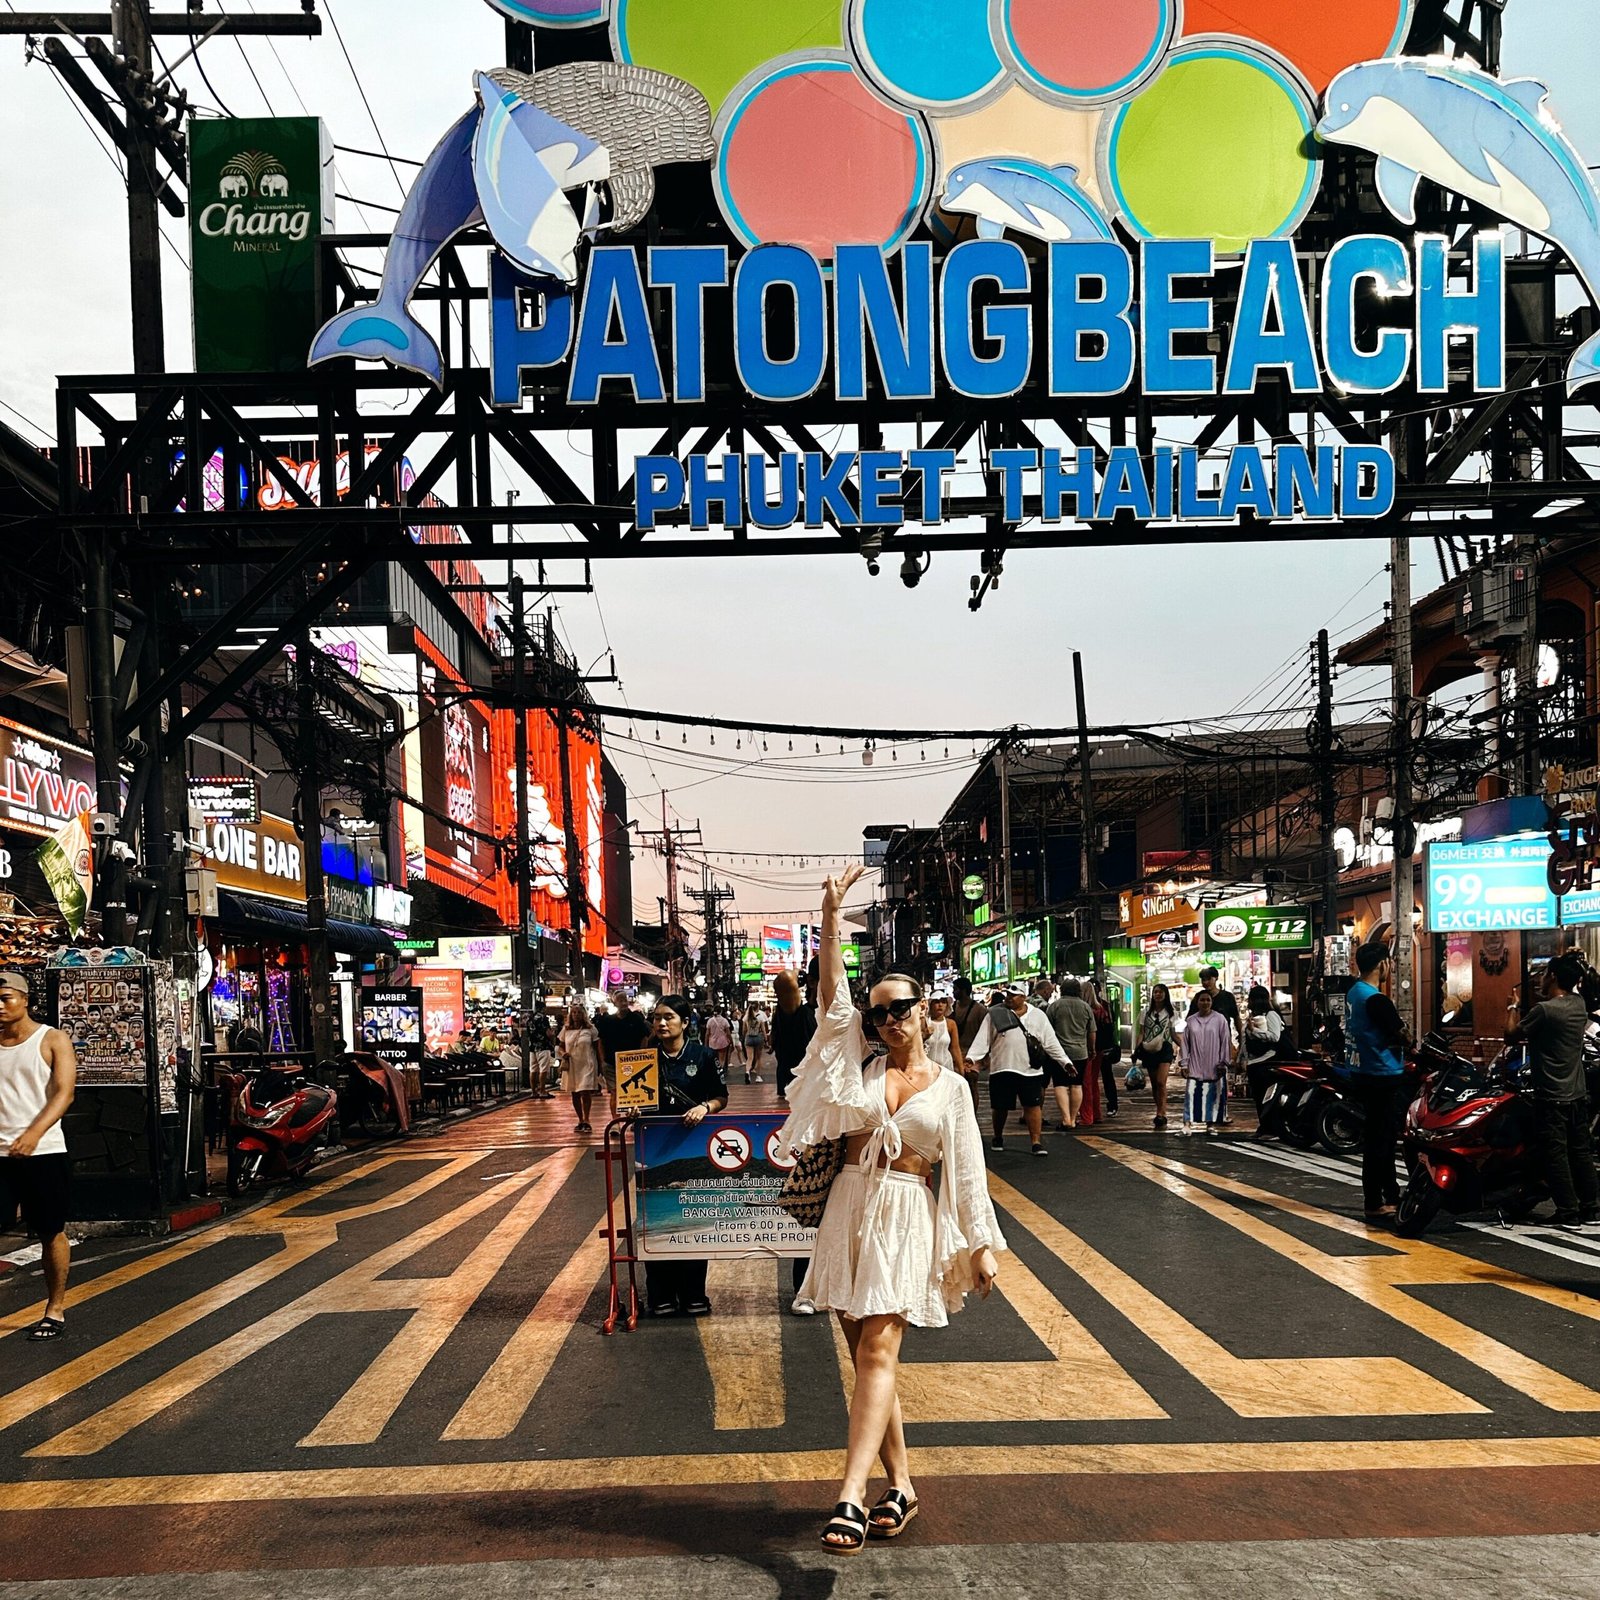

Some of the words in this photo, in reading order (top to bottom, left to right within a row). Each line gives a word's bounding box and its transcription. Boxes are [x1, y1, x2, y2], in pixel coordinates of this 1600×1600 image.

[199, 203, 312, 241] Chang
[634, 449, 957, 531] PHUKET
[988, 442, 1396, 525] THAILAND
[263, 836, 301, 881] BAR
[1434, 874, 1483, 905] 99
[1142, 896, 1175, 918] SINGHA
[1437, 908, 1549, 929] EXCHANGE
[1252, 920, 1307, 934] 1112
[90, 983, 113, 998] 20
[375, 993, 407, 1001] BARBER
[376, 1050, 407, 1058] TATTOO
[619, 1054, 655, 1062] SHOOTING
[682, 1207, 732, 1218] BANGLA
[714, 1220, 747, 1231] (From
[669, 1235, 690, 1243] ALL
[693, 1233, 750, 1242] VEHICLES
[753, 1233, 777, 1242] ARE
